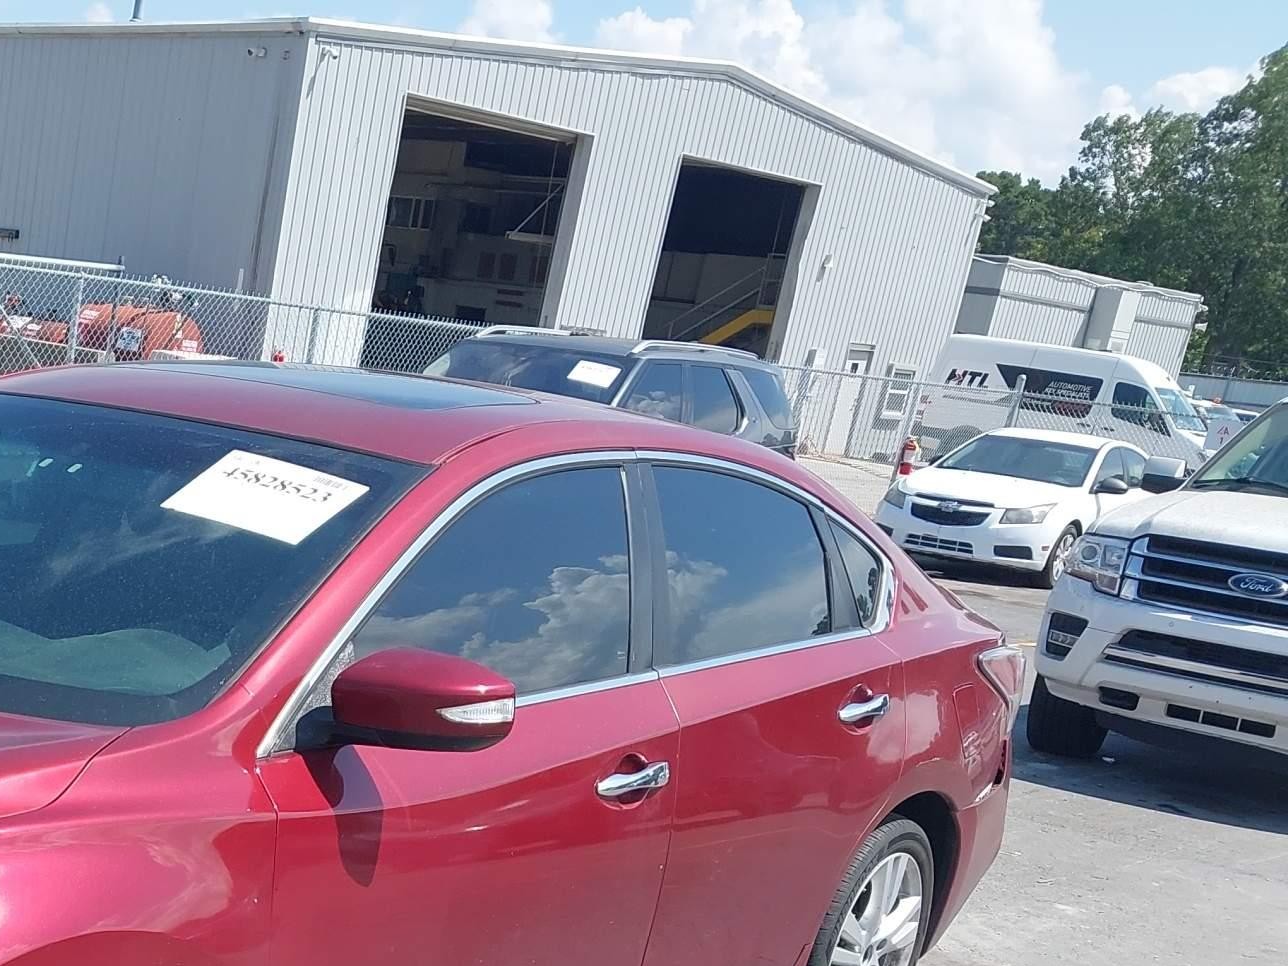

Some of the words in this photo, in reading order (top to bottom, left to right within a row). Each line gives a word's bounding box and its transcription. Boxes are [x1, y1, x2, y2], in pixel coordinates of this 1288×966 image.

[1047, 381, 1093, 394] AUTOMOTIVE
[223, 467, 333, 502] 45828523
[1240, 576, 1274, 593] Ford
